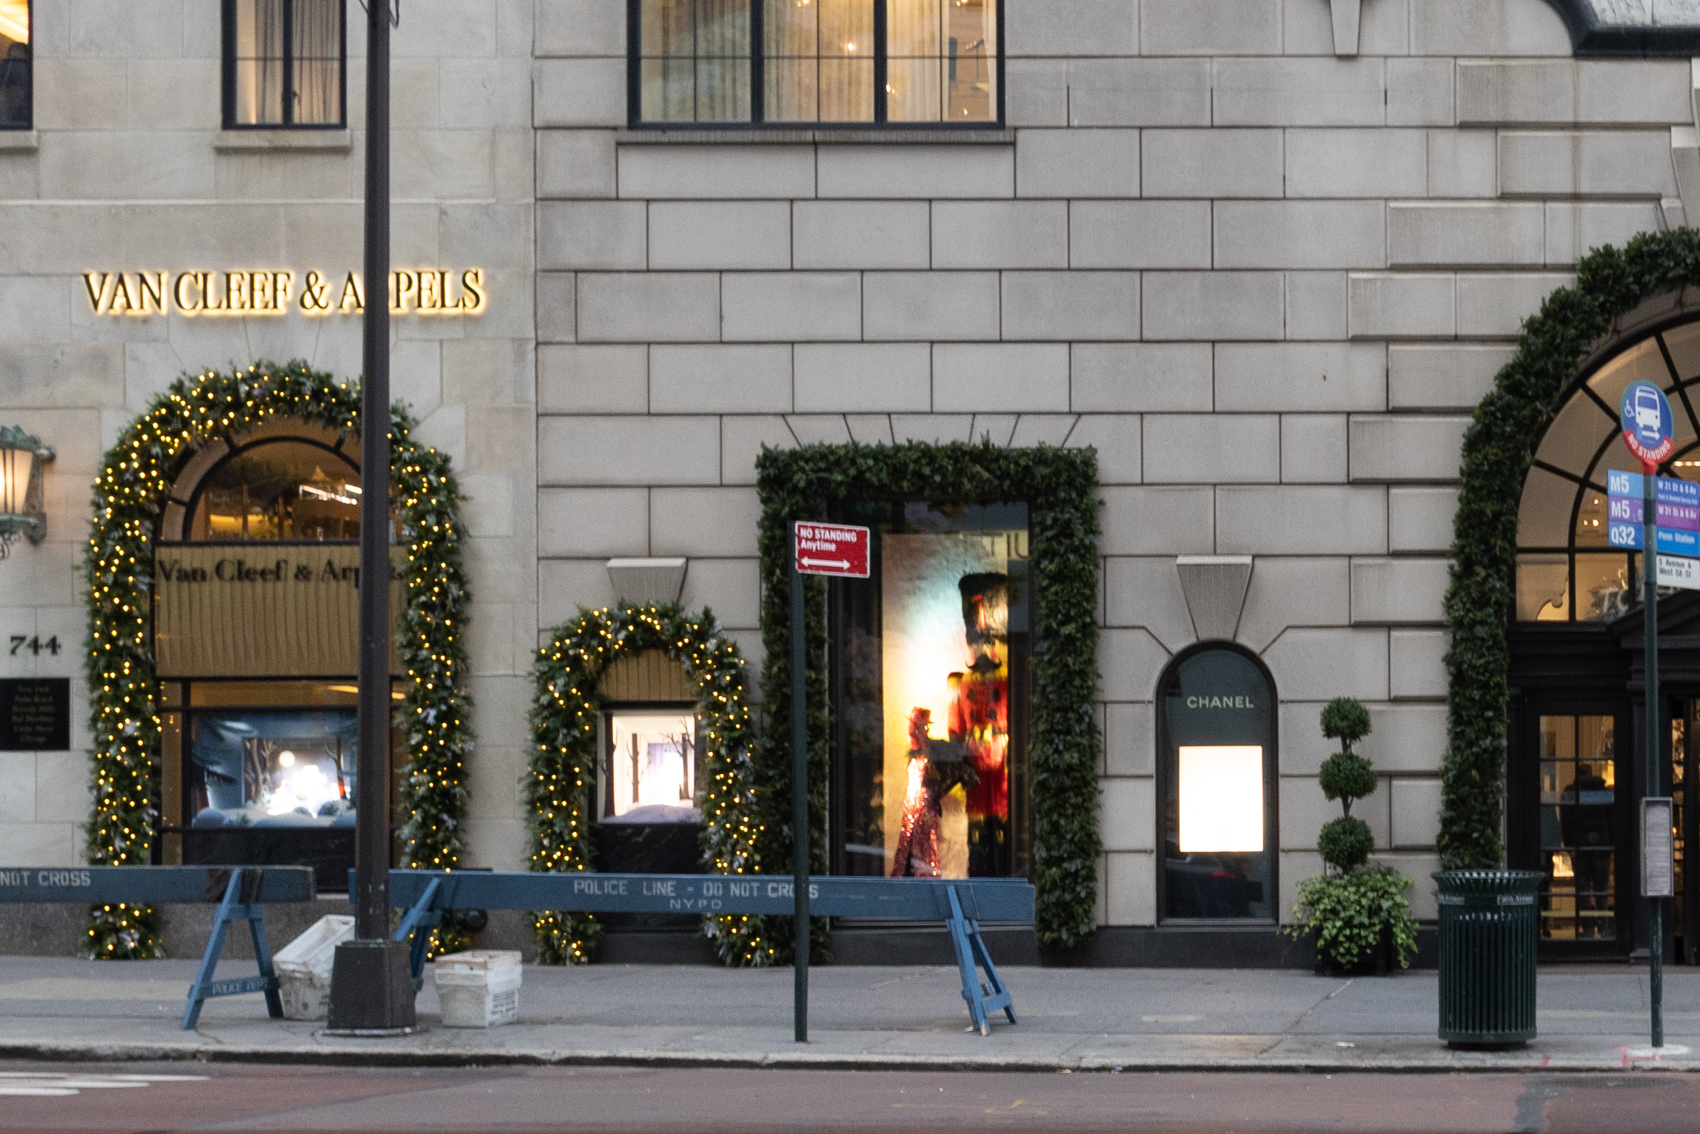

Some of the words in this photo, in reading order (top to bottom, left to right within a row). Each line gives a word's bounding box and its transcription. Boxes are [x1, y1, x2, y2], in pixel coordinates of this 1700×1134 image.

[82, 271, 166, 310] VAN
[174, 271, 292, 310] CLEEF
[300, 270, 330, 310] &
[339, 270, 481, 310] APELS
[1627, 432, 1639, 450] NO
[1637, 439, 1671, 461] STANDING
[1610, 474, 1630, 494] M5
[1611, 499, 1630, 519] M5
[800, 526, 814, 539] NO
[814, 528, 857, 543] STANDING
[1611, 525, 1636, 545] Q32
[1658, 531, 1673, 542] Penn
[1674, 532, 1695, 545] Station
[800, 539, 837, 553] Anytime
[158, 558, 208, 582] Van
[214, 557, 289, 582] Cleef
[294, 563, 312, 582] &
[10, 635, 62, 656] 744
[1186, 695, 1255, 709] CHANEL
[0, 870, 31, 886] NOT
[38, 870, 91, 887] CROSS
[574, 879, 628, 895] POLICE
[643, 880, 676, 896] LINE
[703, 881, 723, 897] DO
[730, 882, 761, 897] NOT
[669, 898, 722, 910] NYPD
